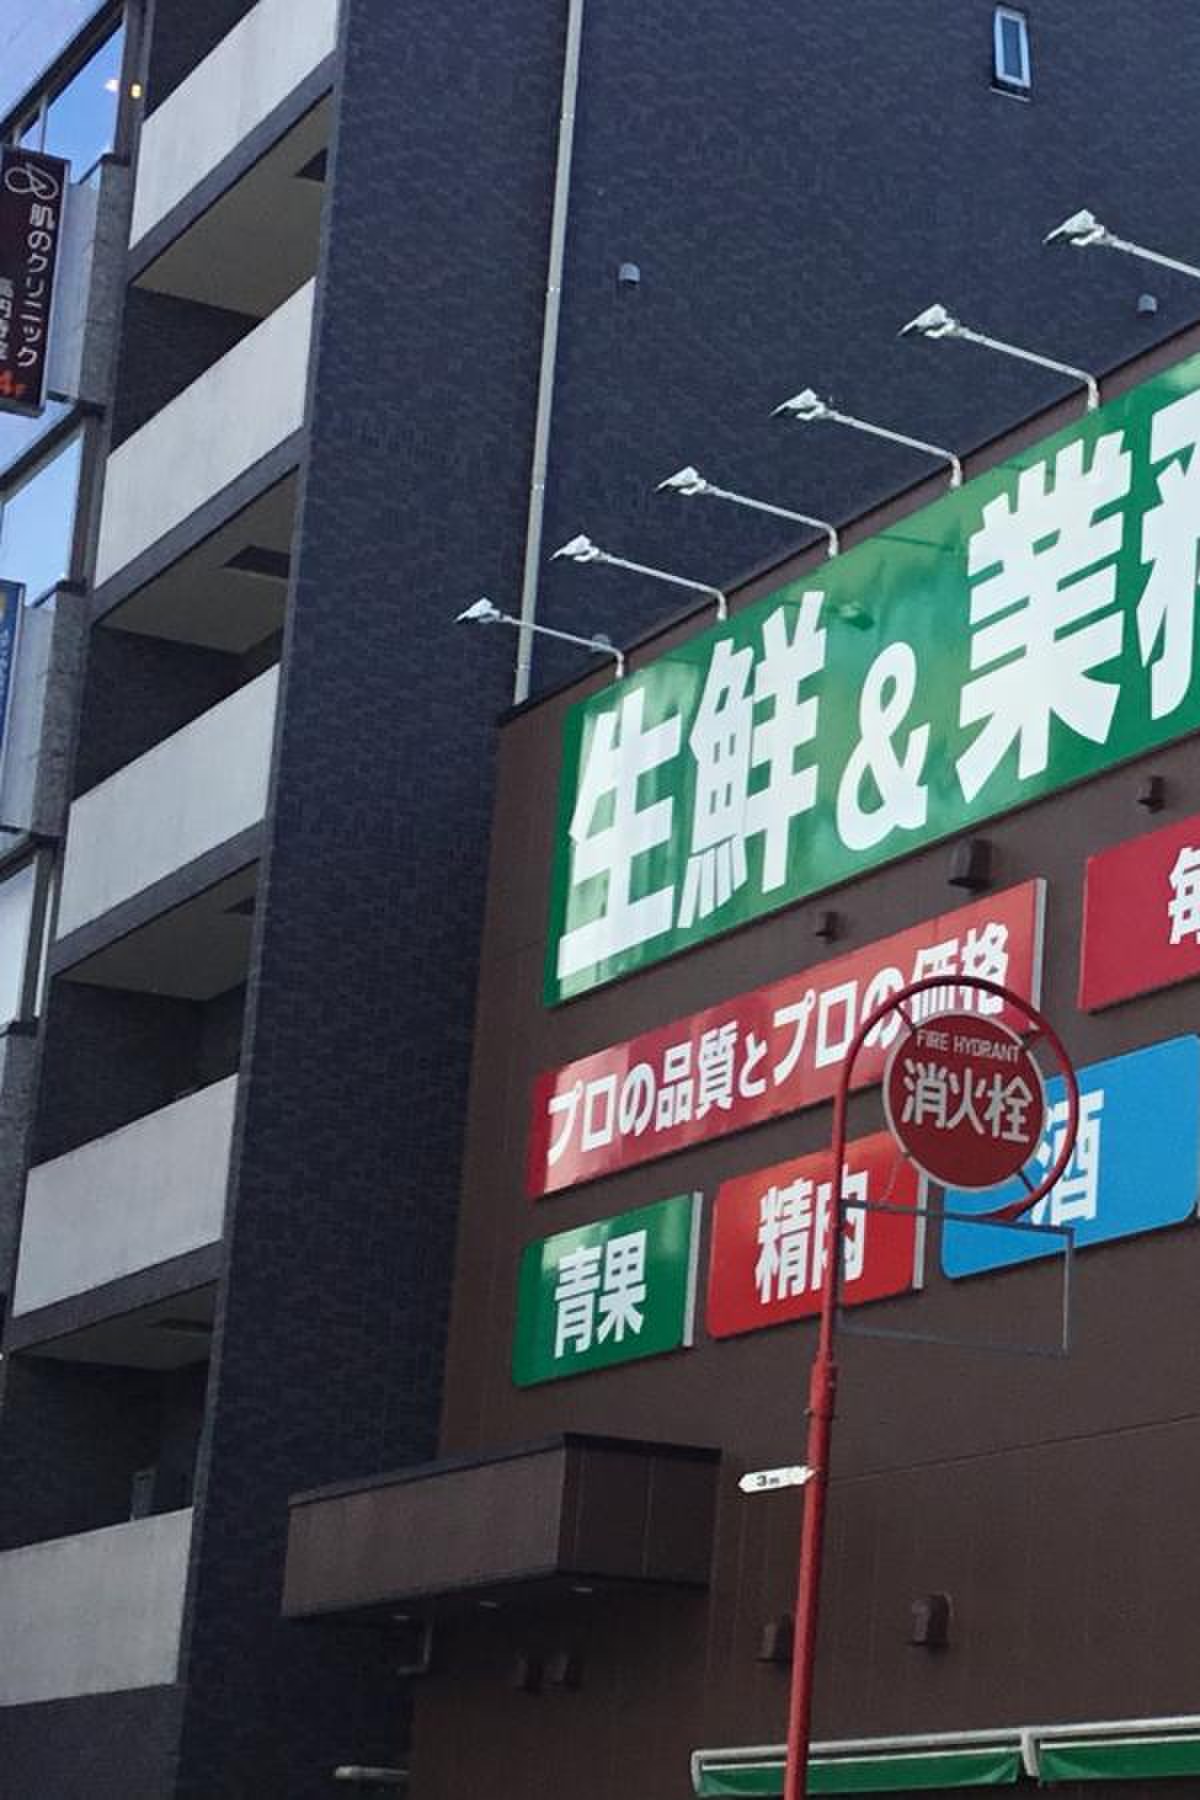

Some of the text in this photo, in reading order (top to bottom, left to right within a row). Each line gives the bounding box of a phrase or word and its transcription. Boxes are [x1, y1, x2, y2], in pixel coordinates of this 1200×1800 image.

[547, 921, 1009, 1166] プロの品質とプロの価格
[902, 1058, 1033, 1143] 消火栓
[917, 1029, 1019, 1064] FIRE HYDRANT
[1032, 1090, 1104, 1226] 酒
[553, 1230, 647, 1358] 青果
[754, 1164, 869, 1305] 精肉
